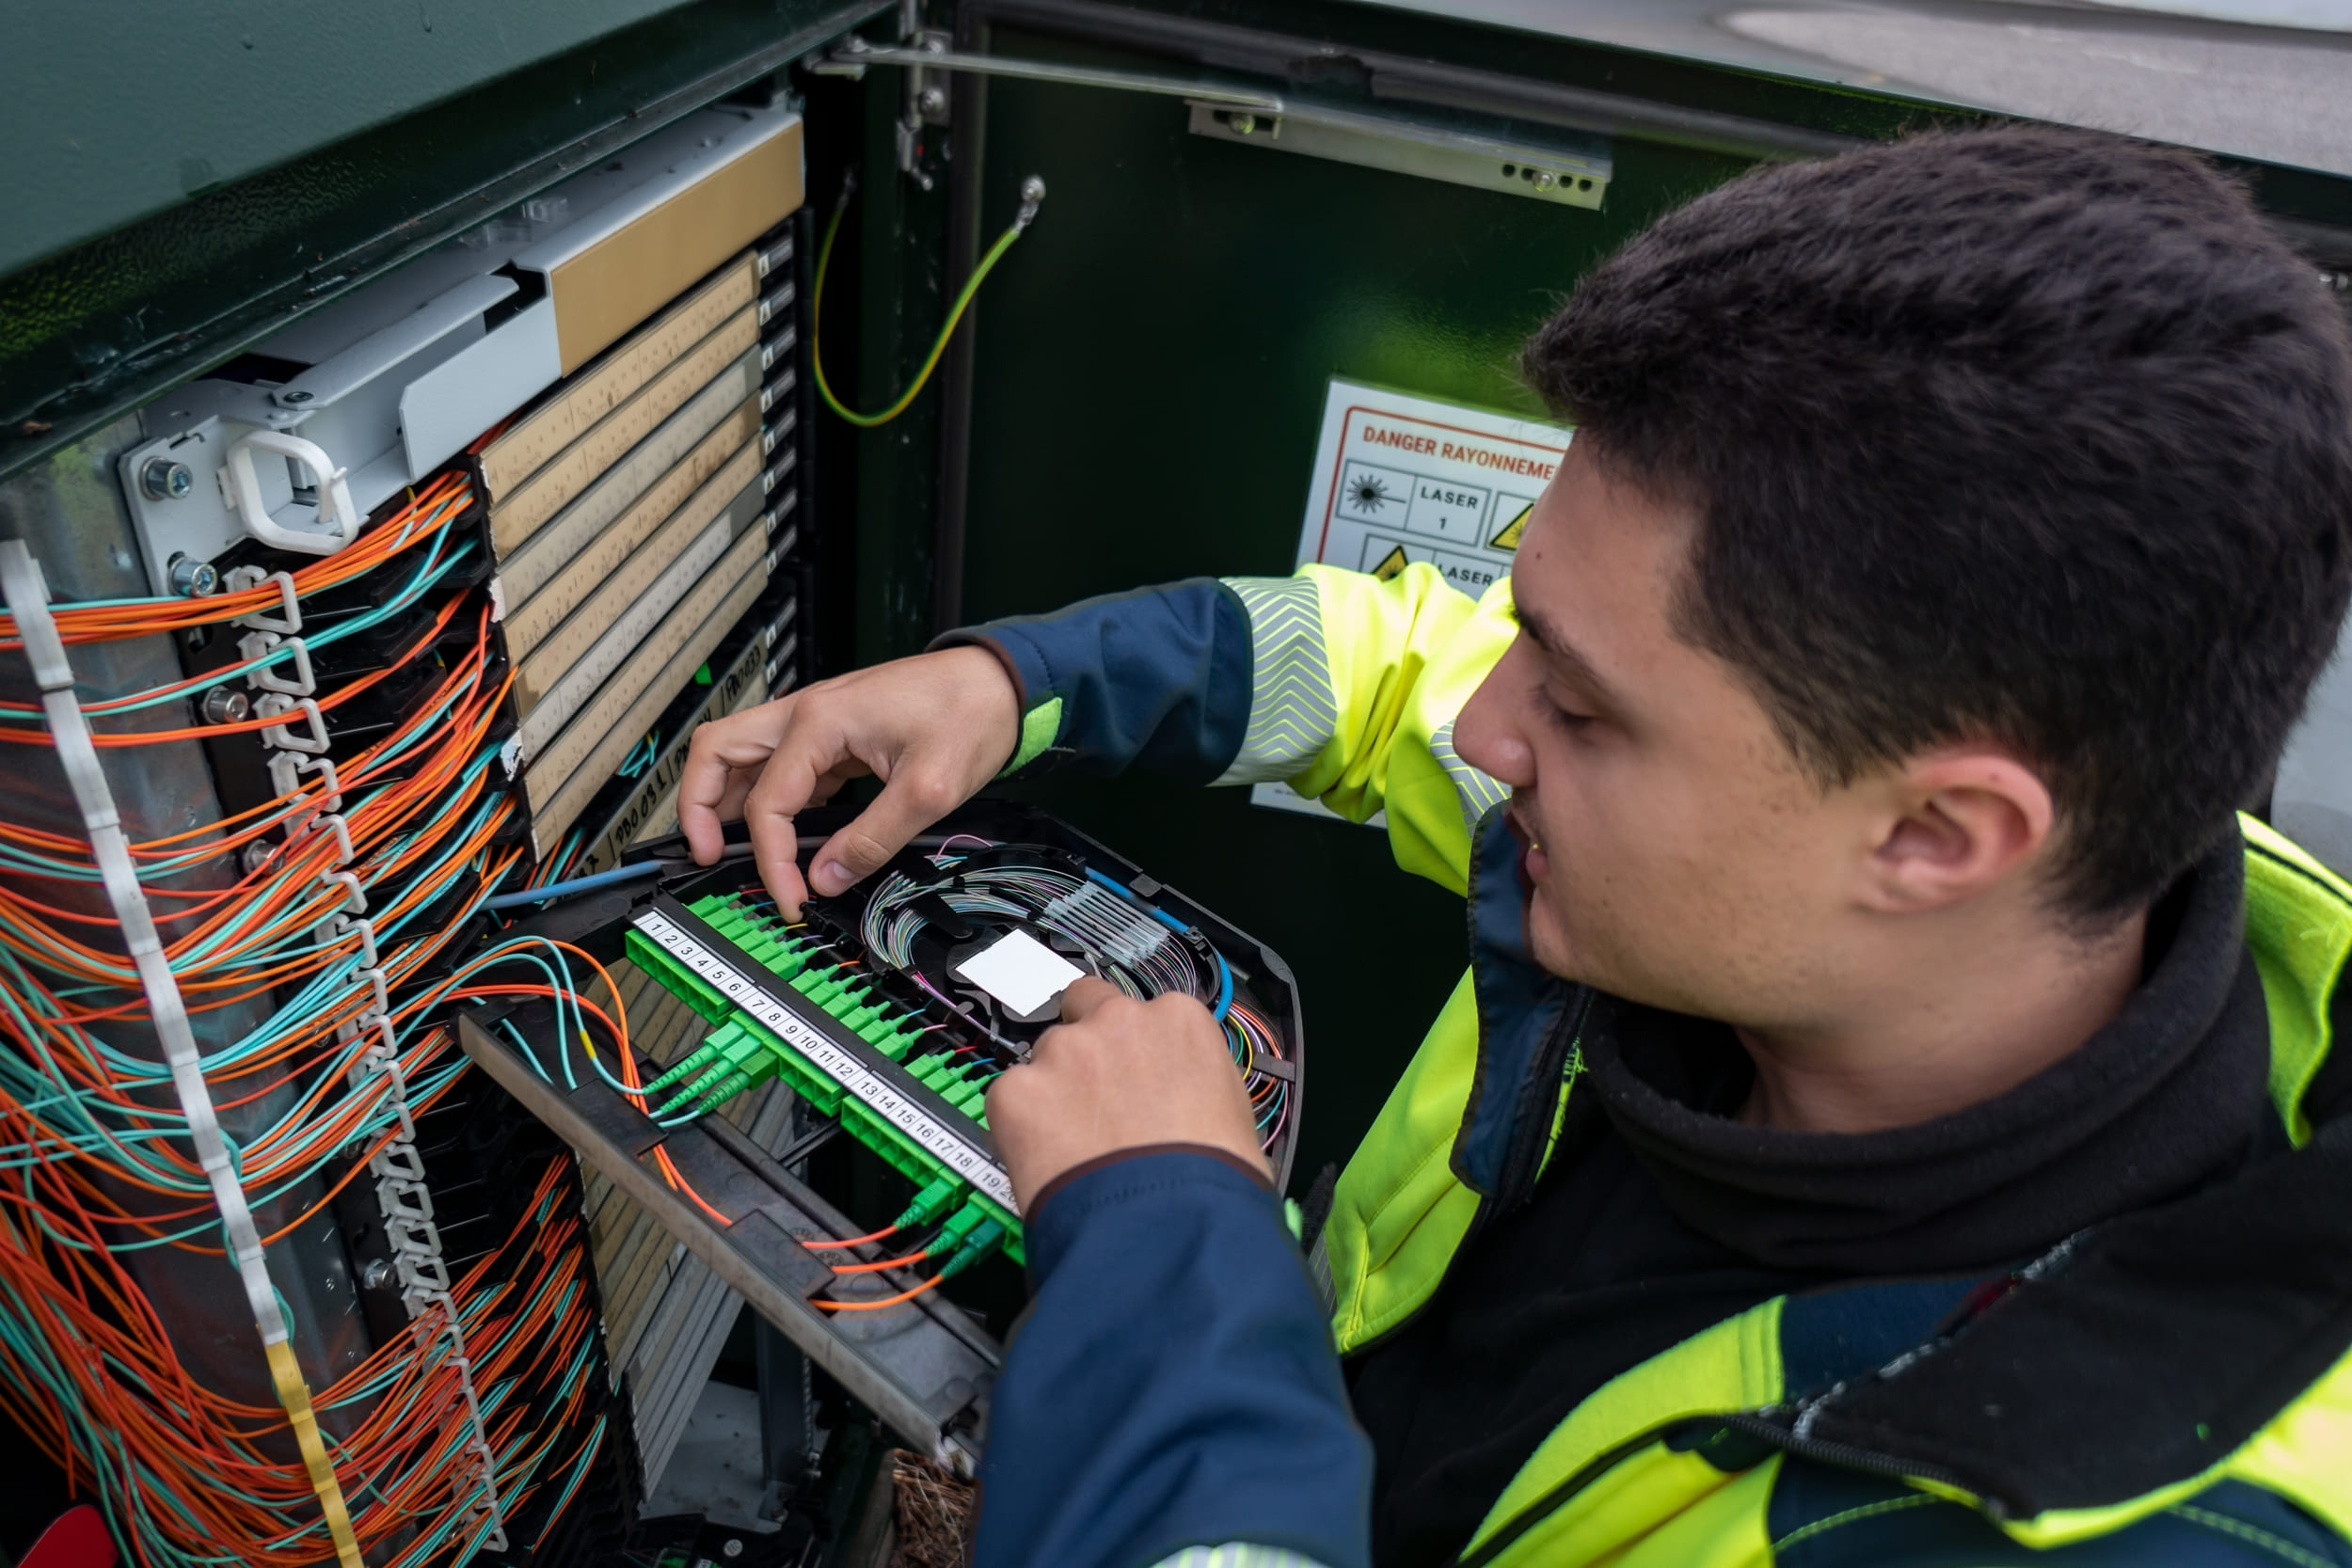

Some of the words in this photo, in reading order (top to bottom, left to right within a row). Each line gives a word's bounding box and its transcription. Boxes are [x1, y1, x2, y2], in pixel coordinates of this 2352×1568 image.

[1363, 425, 1438, 456] DANGER
[1440, 442, 1557, 482] RAYONNEME
[1421, 485, 1479, 509] LASER
[1438, 516, 1447, 530] 1
[664, 935, 678, 943] 2
[680, 946, 693, 955] 3
[712, 971, 725, 979] 5
[728, 983, 741, 991] 6
[752, 999, 766, 1007] 7
[768, 1012, 781, 1022] 8
[785, 1025, 798, 1035] 9
[800, 1036, 818, 1050] 10
[818, 1050, 835, 1063] 11
[835, 1062, 853, 1076] 12
[860, 1081, 878, 1096] 13
[879, 1096, 897, 1109] 14
[897, 1109, 916, 1123] 15
[916, 1123, 934, 1137] 16
[935, 1138, 954, 1151] 17
[954, 1152, 973, 1166] 18
[982, 1172, 1001, 1187] 19
